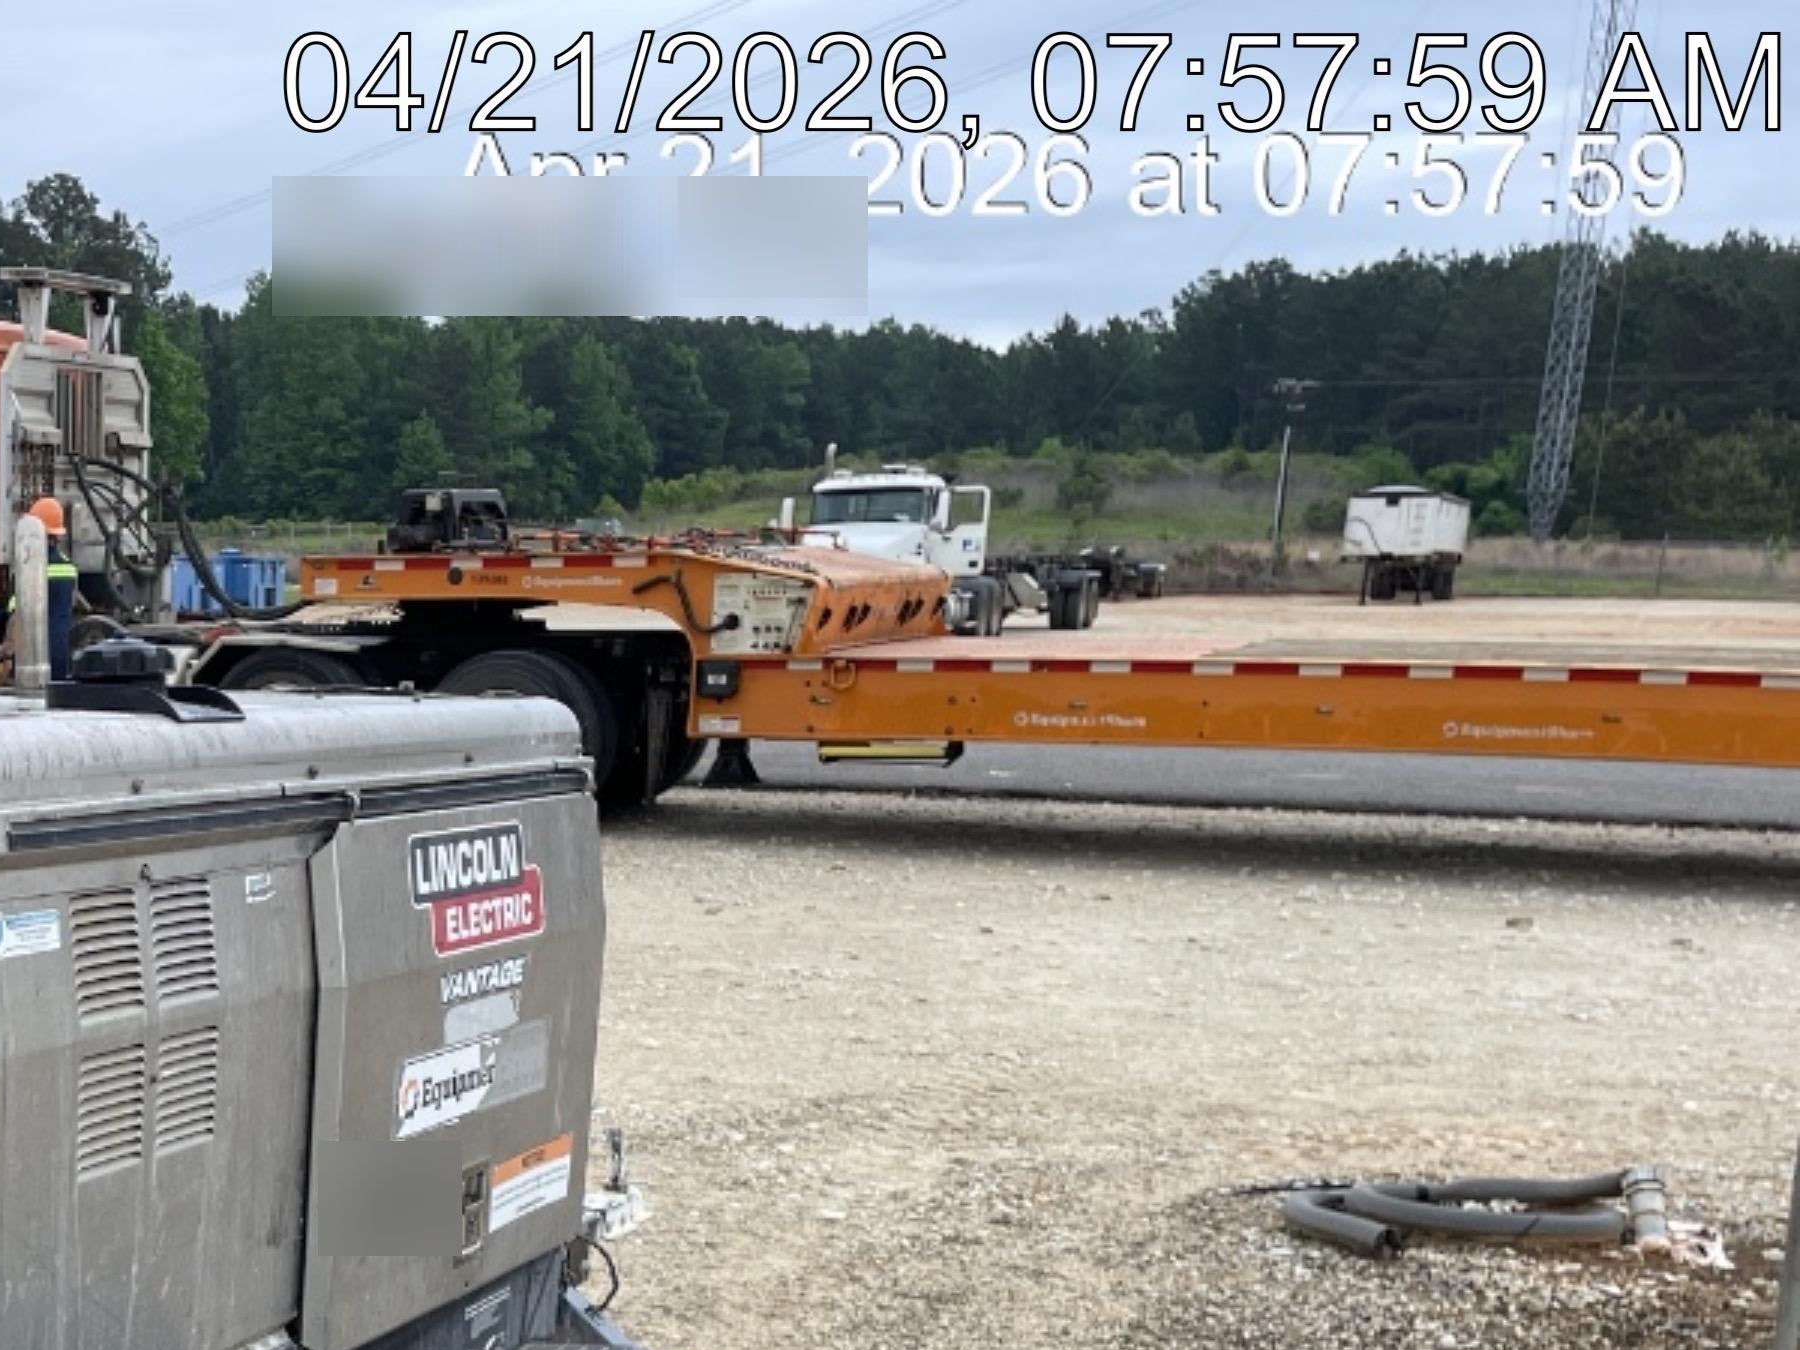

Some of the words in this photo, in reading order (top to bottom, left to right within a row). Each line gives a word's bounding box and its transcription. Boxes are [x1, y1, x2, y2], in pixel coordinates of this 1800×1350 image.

[416, 834, 519, 894] LINCOLN
[446, 893, 532, 943] ELECTRIC
[440, 955, 527, 1003] VANTAGE
